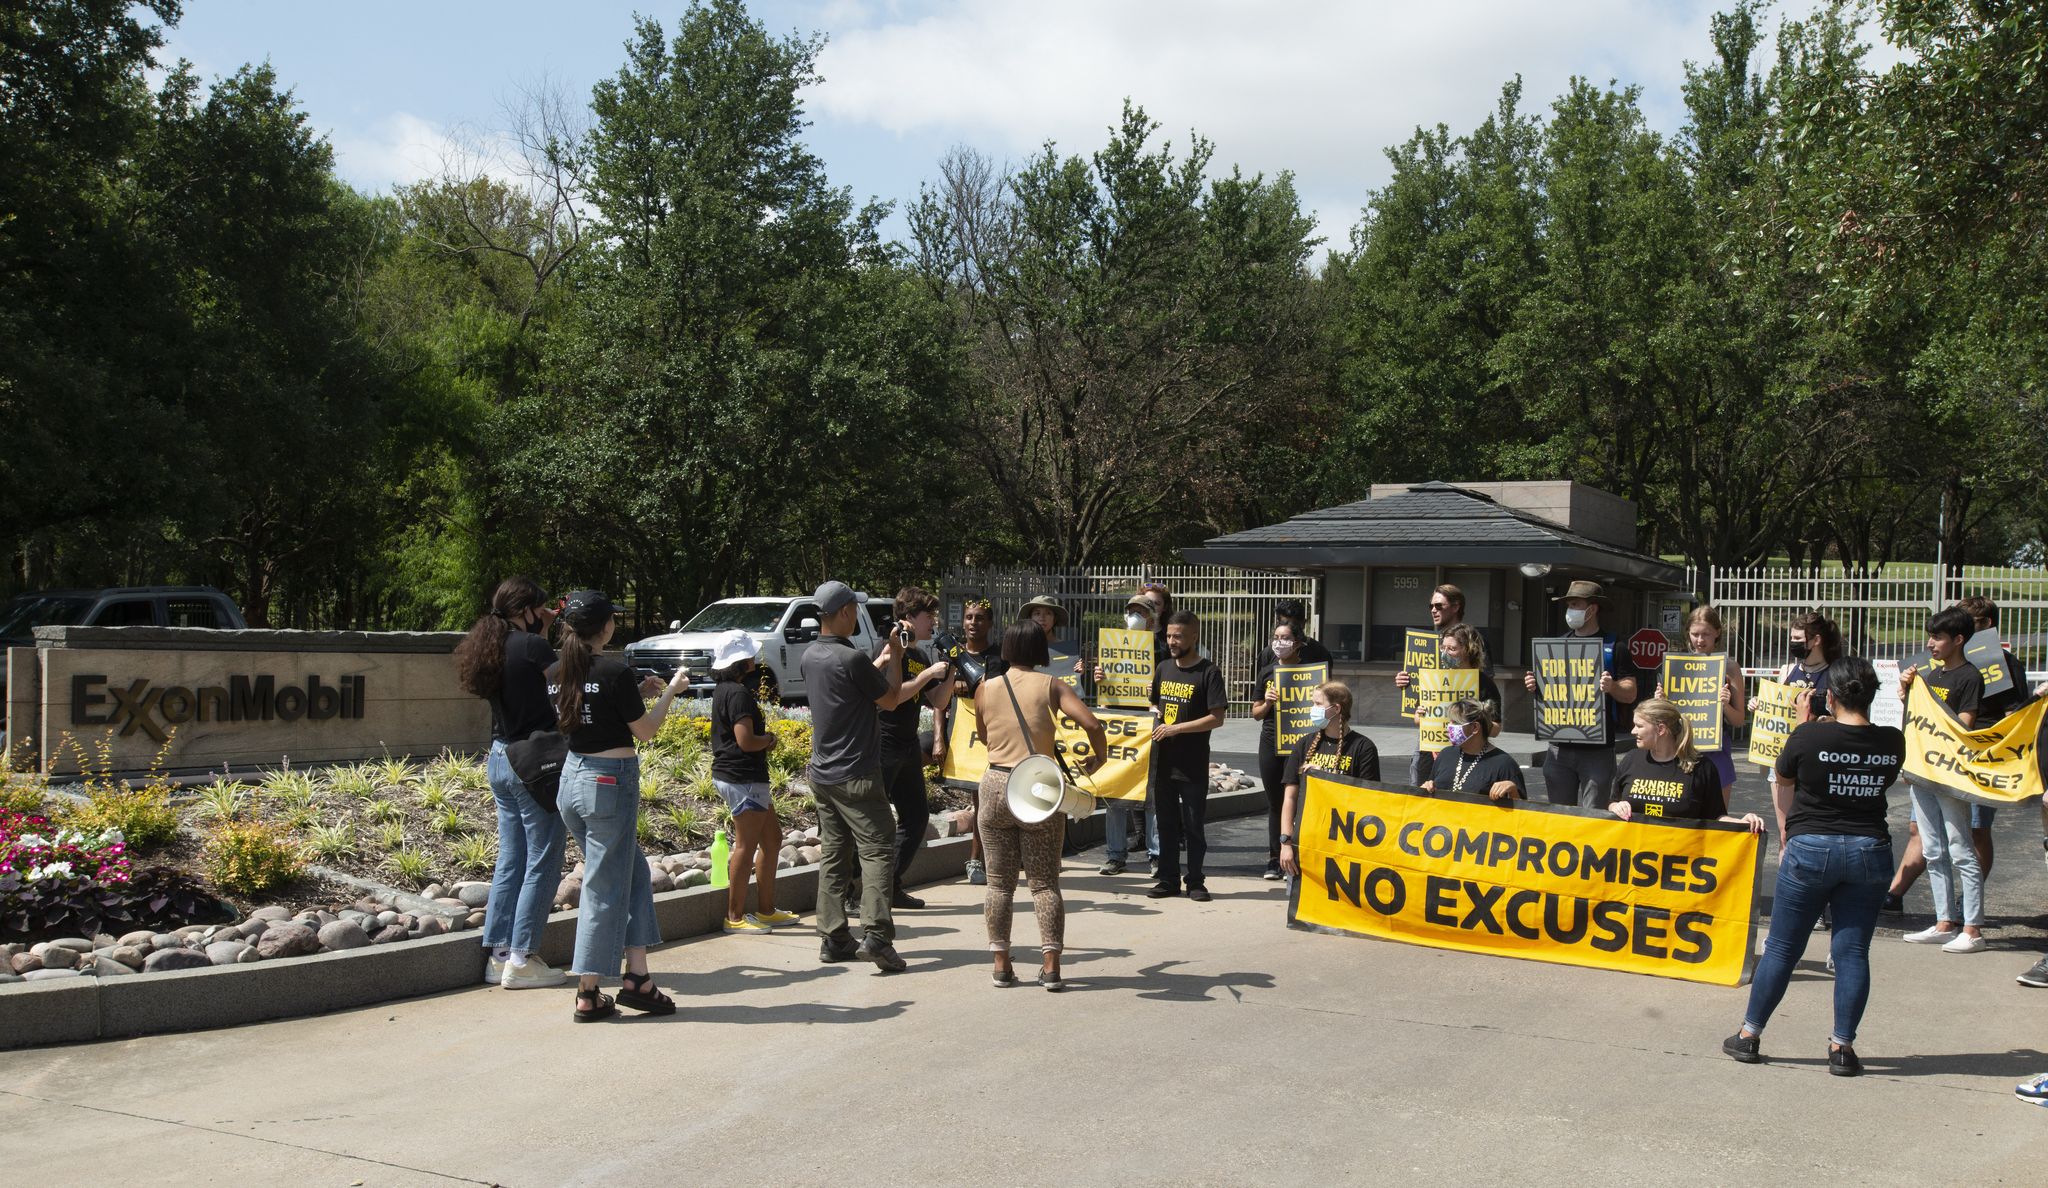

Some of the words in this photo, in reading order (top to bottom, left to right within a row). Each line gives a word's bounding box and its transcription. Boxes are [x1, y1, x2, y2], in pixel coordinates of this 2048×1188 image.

[1394, 576, 1419, 589] 5959
[1123, 636, 1129, 645] A
[1414, 638, 1428, 647] OUR
[1101, 647, 1151, 660] BETTER
[1631, 640, 1667, 657] STOP
[1407, 650, 1435, 669] LIVES
[1684, 662, 1707, 671] OUR
[1101, 662, 1151, 675] WORLD
[1541, 658, 1566, 677] FOR
[1569, 658, 1595, 677] THE
[1293, 673, 1312, 681] OUR
[1443, 677, 1450, 687] A
[1160, 680, 1195, 693] SUNRISE
[1670, 676, 1717, 694] LIVES
[1281, 684, 1317, 702] LIVE
[1421, 689, 1476, 702] BETTER
[1543, 683, 1568, 701] AIR
[1571, 683, 1595, 702] WE
[1776, 691, 1783, 701] A
[71, 674, 366, 745] ExxonMobil
[1678, 699, 1708, 707] OVER
[1758, 700, 1797, 719] BETTE
[1289, 706, 1312, 715] OVE
[1544, 707, 1597, 726] BREATHE
[1060, 716, 1139, 737] CSE
[1755, 715, 1793, 735] WORL
[1421, 729, 1450, 743] POSS
[1692, 727, 1716, 739] FITS
[1773, 736, 1781, 745] IS
[1072, 741, 1139, 761] OER
[1751, 740, 1783, 757] POSS
[1818, 750, 1860, 764] GOOD
[1863, 754, 1898, 765] JOBS
[1631, 778, 1684, 793] SUNRISE
[1828, 773, 1886, 786] LIVABLE
[1630, 785, 1683, 799] MOVEMENT
[1828, 784, 1882, 797] FUTURE
[1327, 806, 1387, 849] NO
[1398, 820, 1718, 895] COMPROMISES
[1323, 856, 1408, 917] NO
[1424, 874, 1714, 965] EXCUSES
